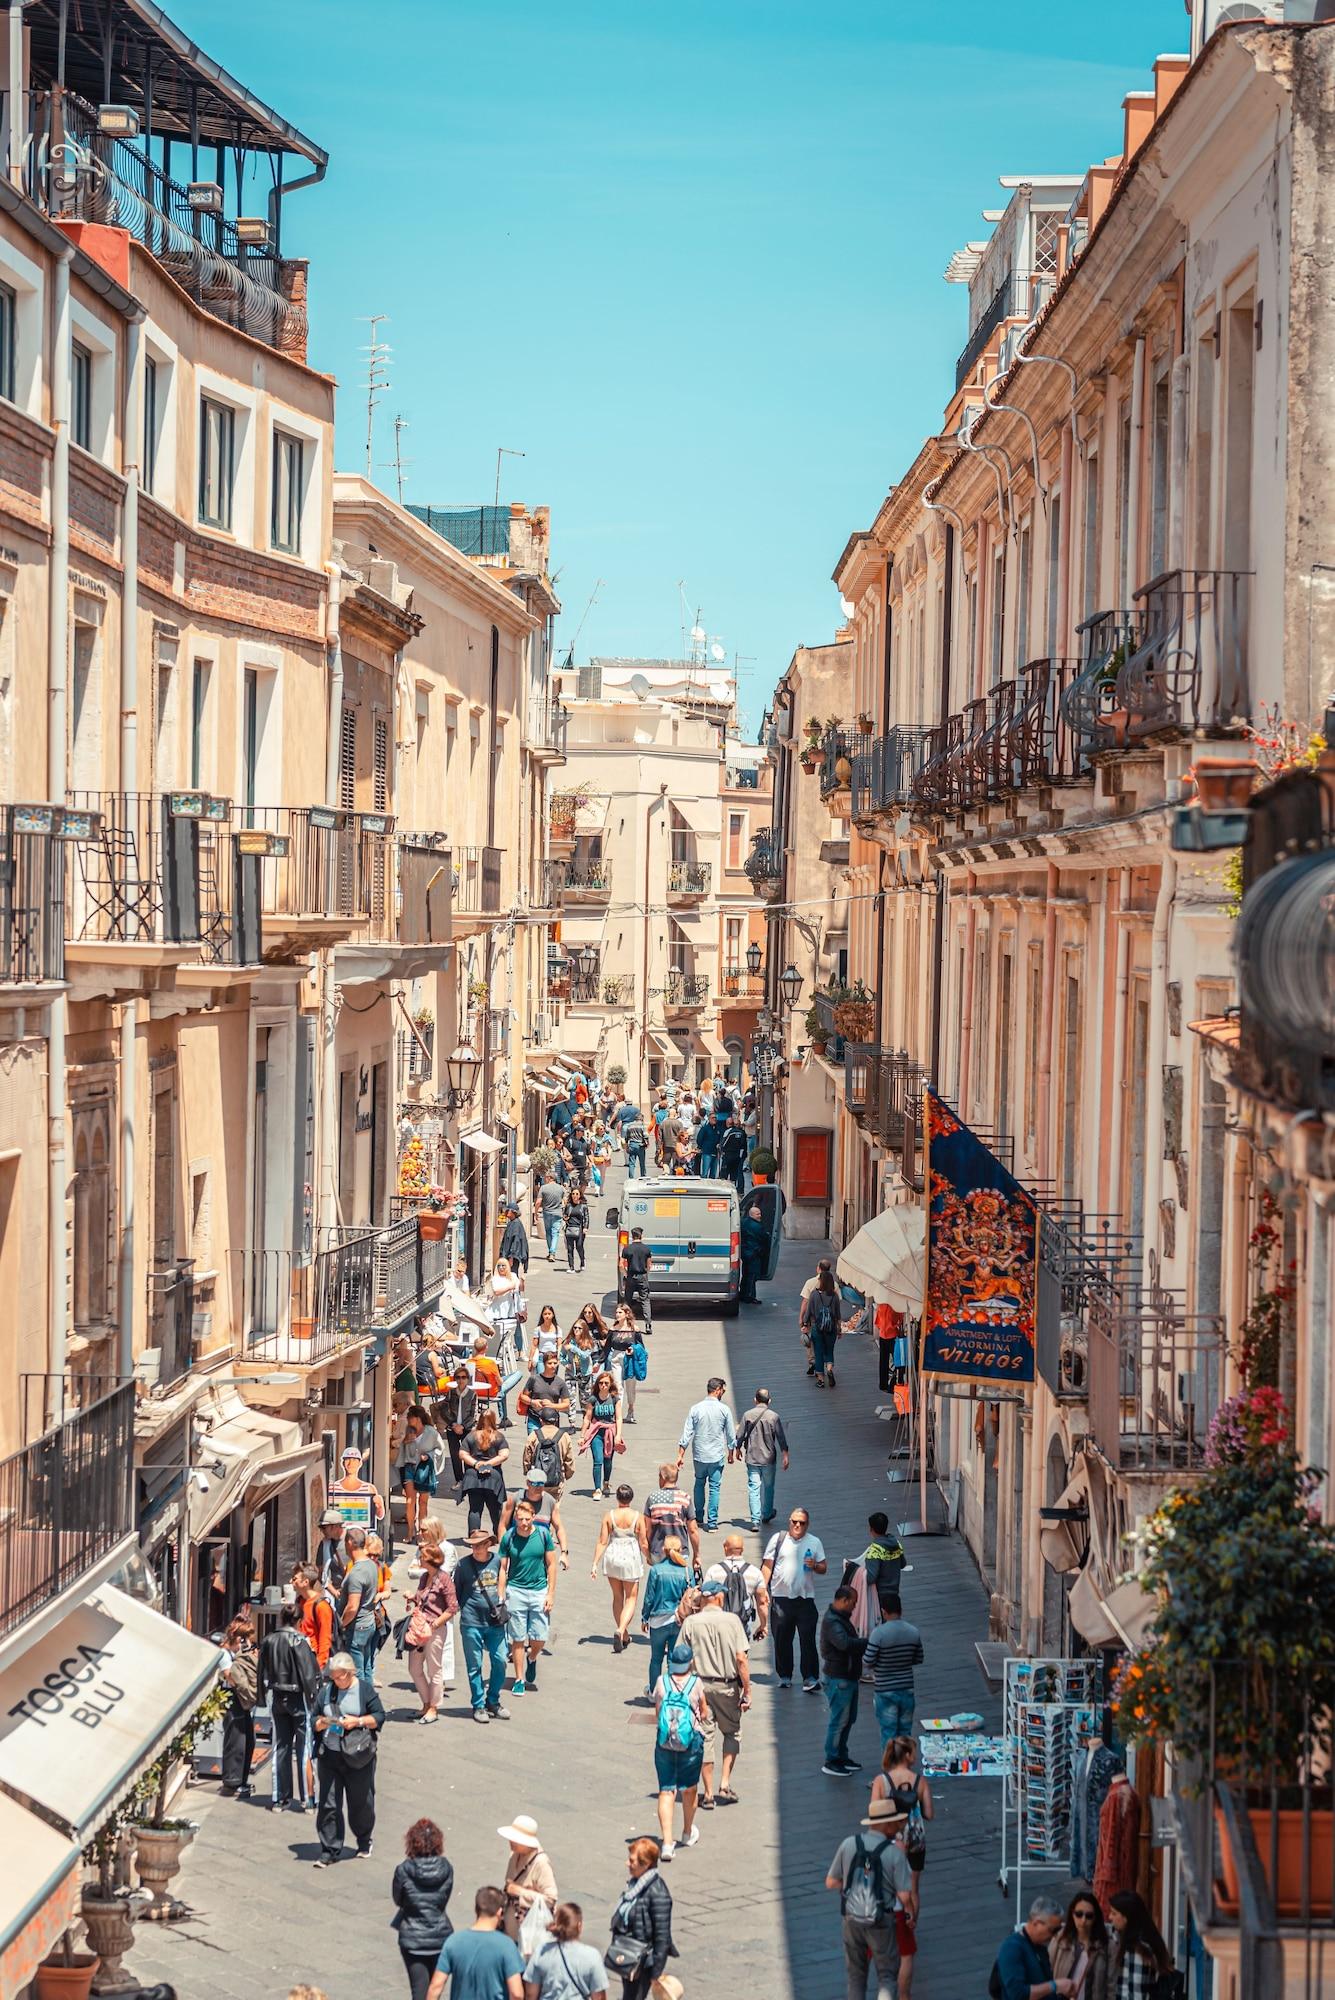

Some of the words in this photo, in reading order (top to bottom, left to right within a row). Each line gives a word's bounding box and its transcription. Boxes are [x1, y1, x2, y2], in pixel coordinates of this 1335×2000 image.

[945, 1328, 993, 1339] APARTMENT
[1002, 1335, 1022, 1343] LOFT
[956, 1339, 1011, 1352] TAORMINA
[7, 1644, 115, 1727] TOSCA
[70, 1680, 125, 1729] BLU
